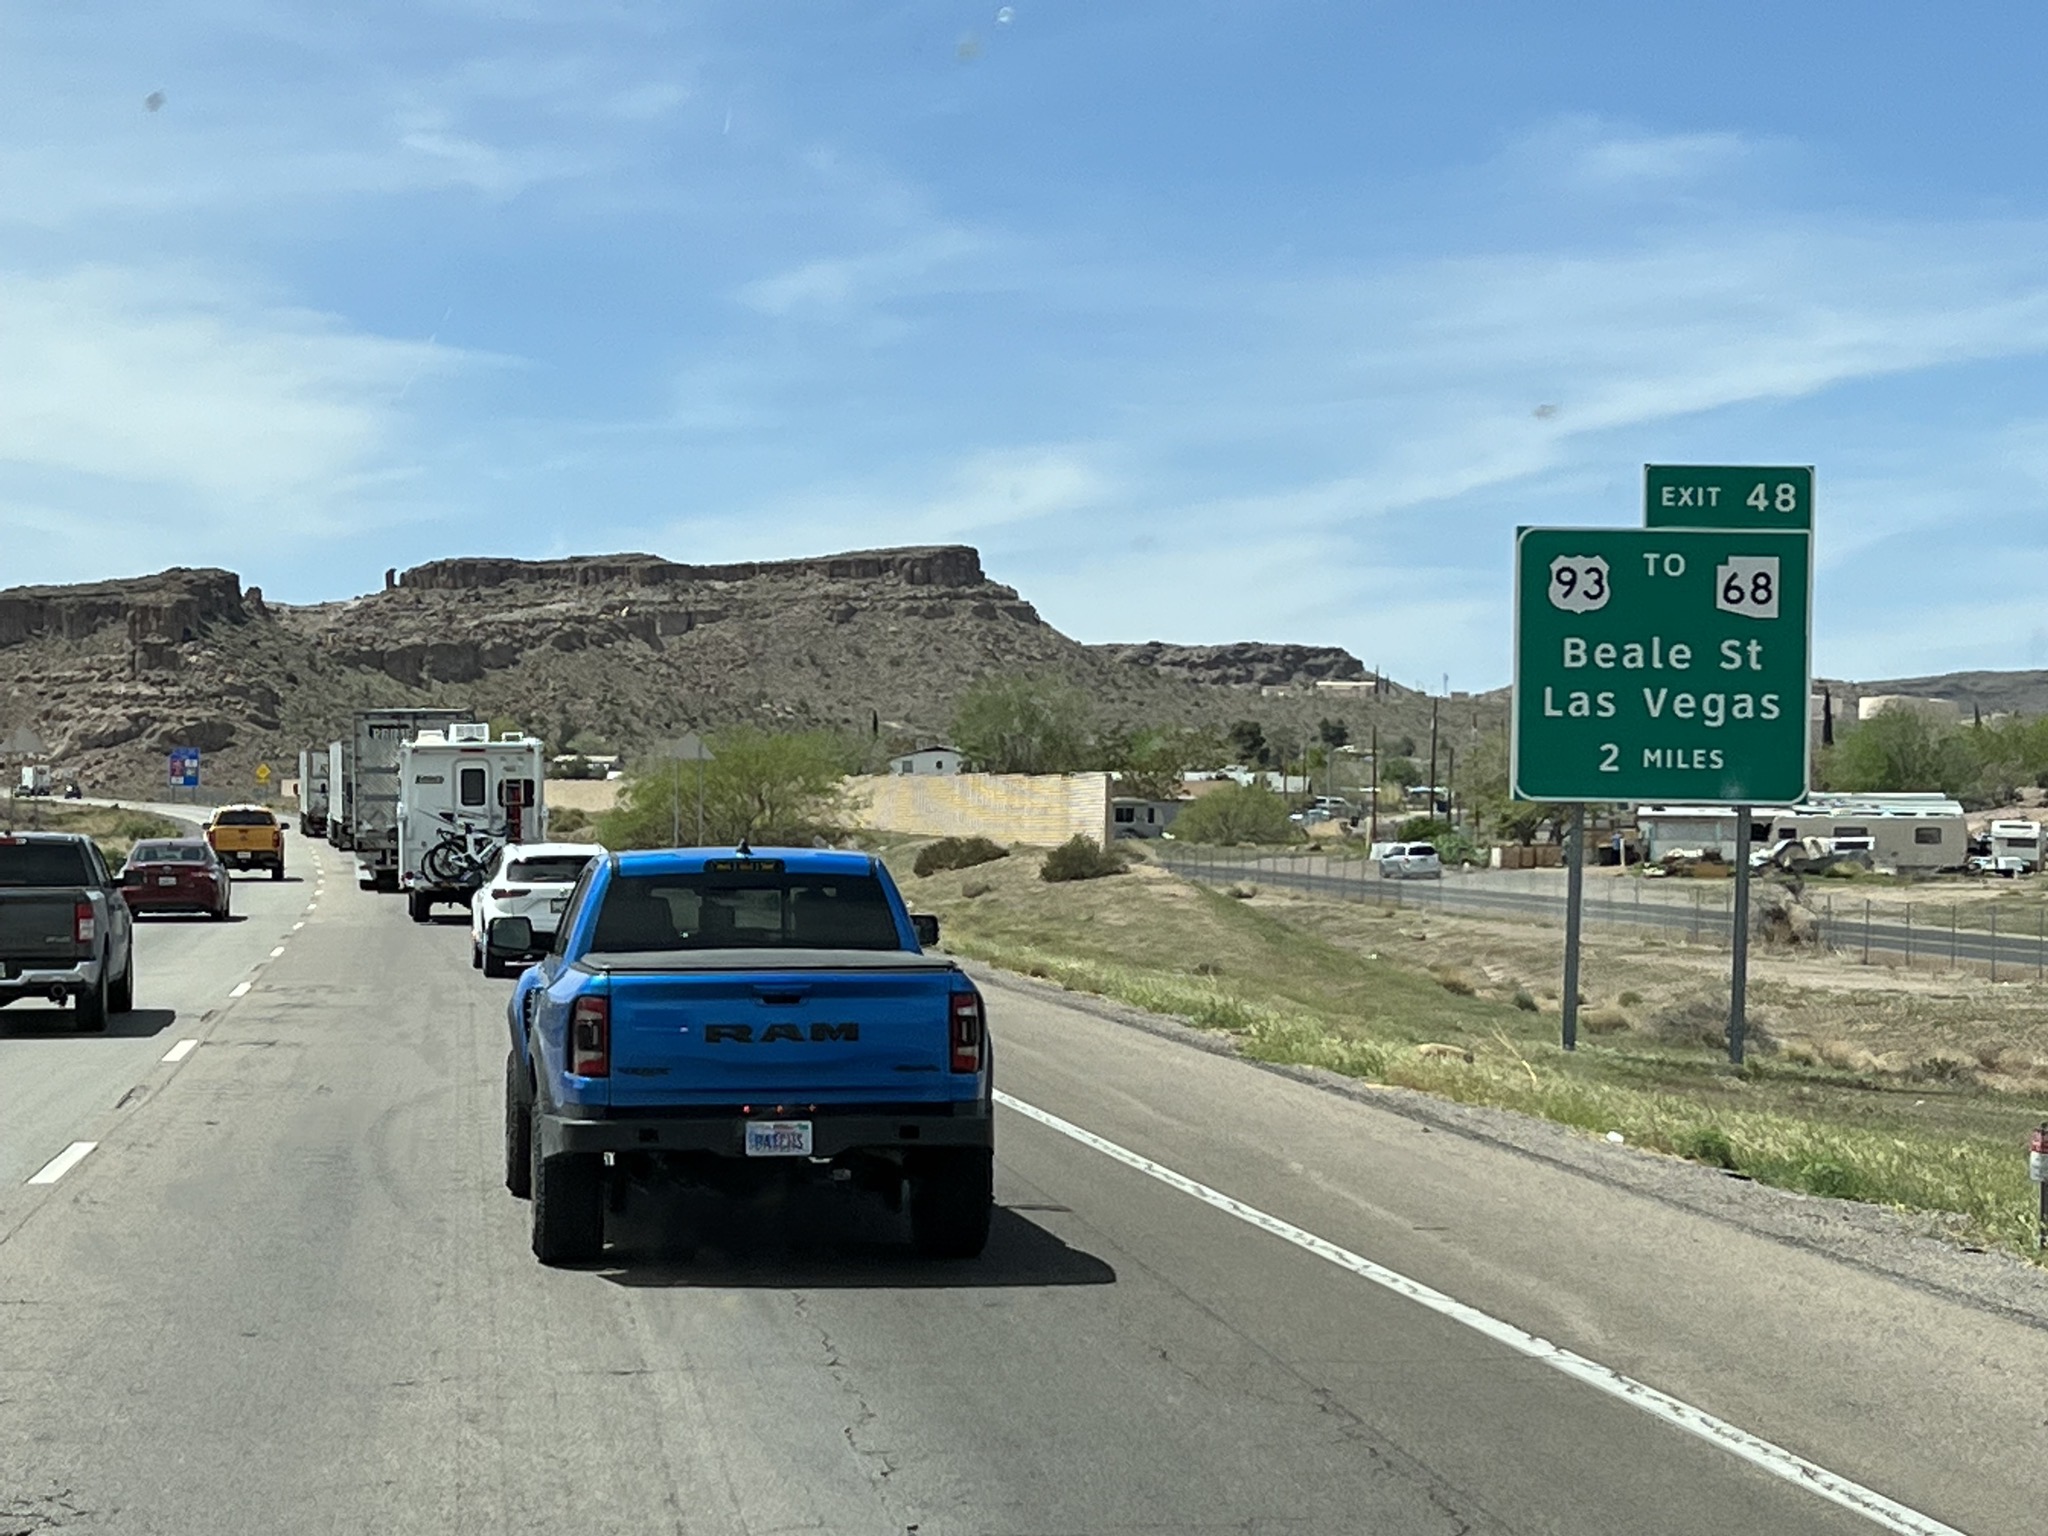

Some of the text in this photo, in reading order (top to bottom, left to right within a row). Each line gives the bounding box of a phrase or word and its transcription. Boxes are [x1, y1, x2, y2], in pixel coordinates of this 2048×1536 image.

[1663, 484, 1795, 511] EXIT 48
[1556, 554, 1772, 605] 93 TO 68
[1565, 637, 1761, 669] Beale St
[1546, 687, 1779, 726] Las Vegas
[1600, 744, 1722, 771] 2 MILES
[705, 1022, 859, 1043] RAM
